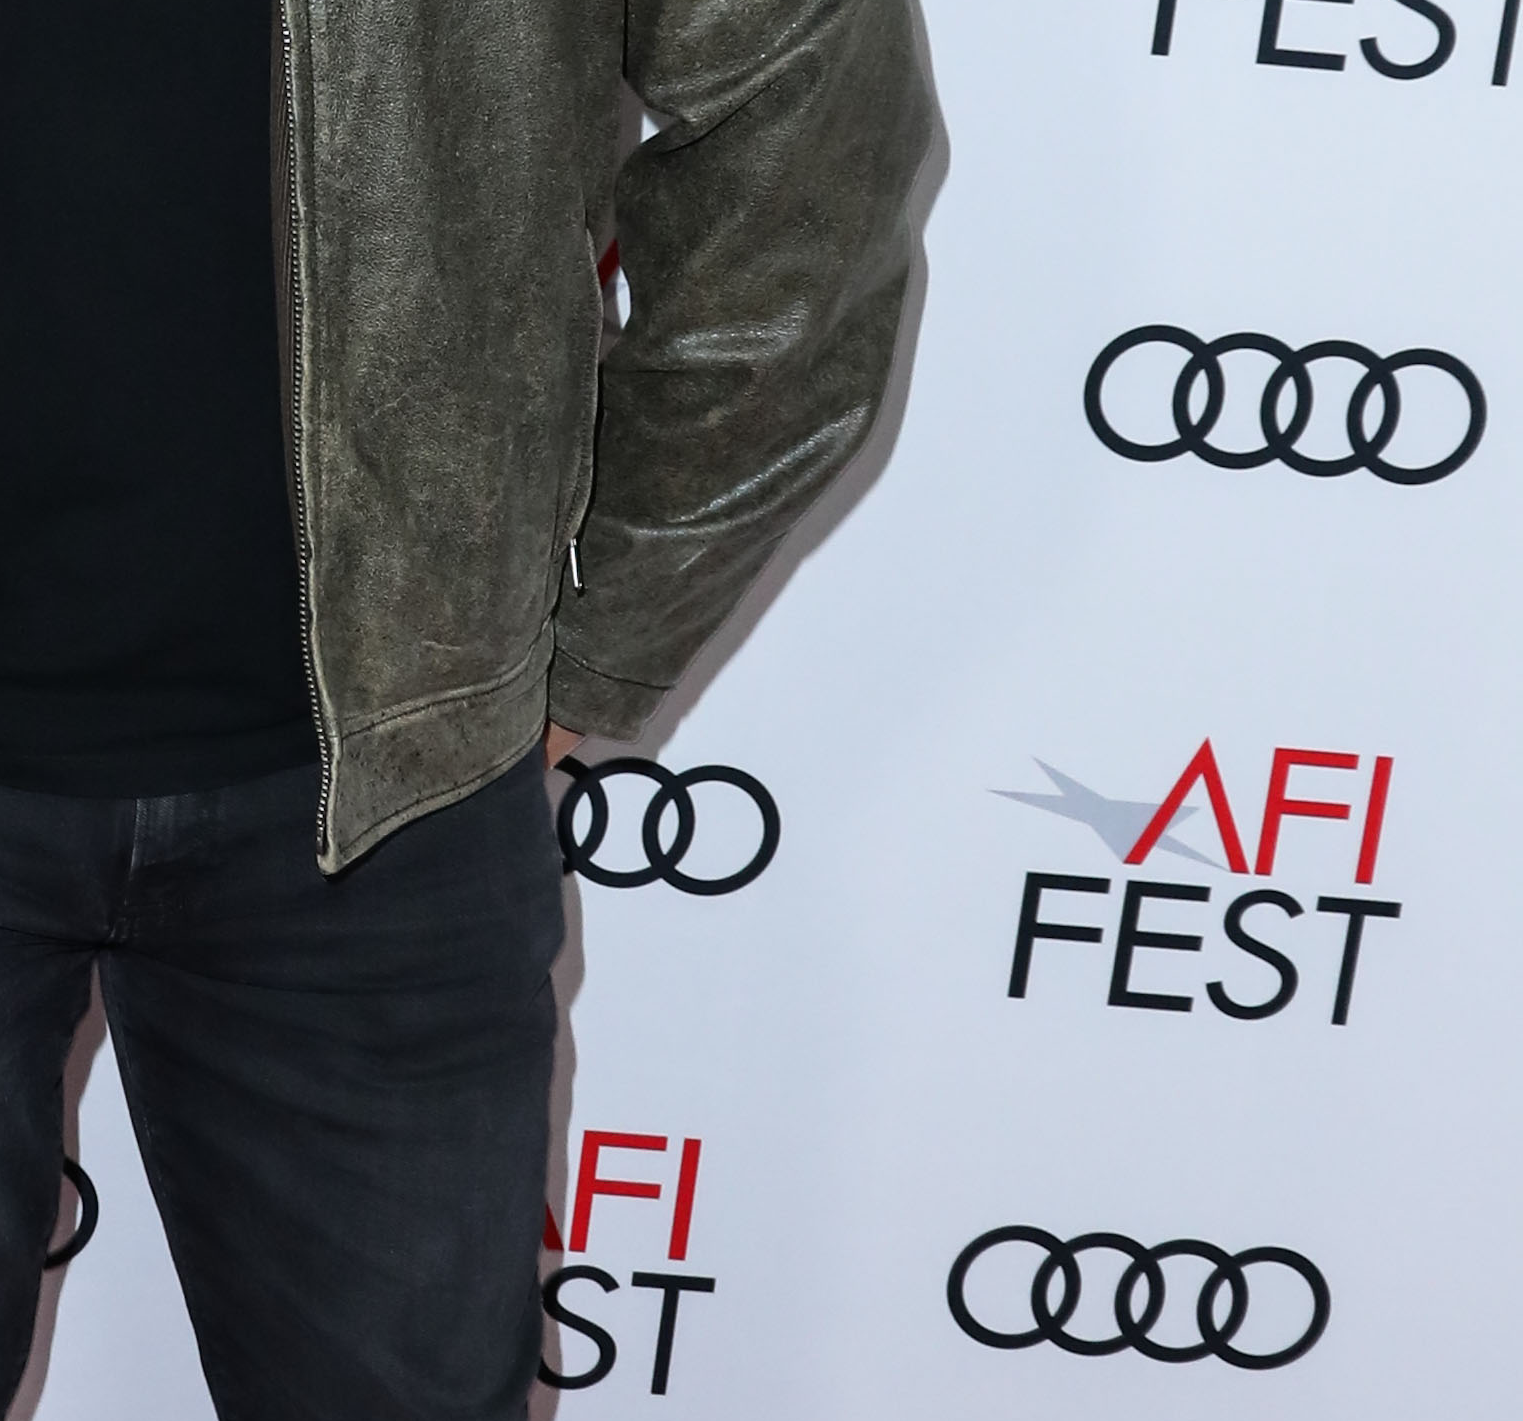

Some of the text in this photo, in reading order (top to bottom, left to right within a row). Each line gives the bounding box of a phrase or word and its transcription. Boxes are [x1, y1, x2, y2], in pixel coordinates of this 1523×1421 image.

[1124, 738, 1394, 885] AFI
[1008, 872, 1402, 1027] FEST
[543, 1130, 702, 1261] FI
[537, 1265, 717, 1396] ST
